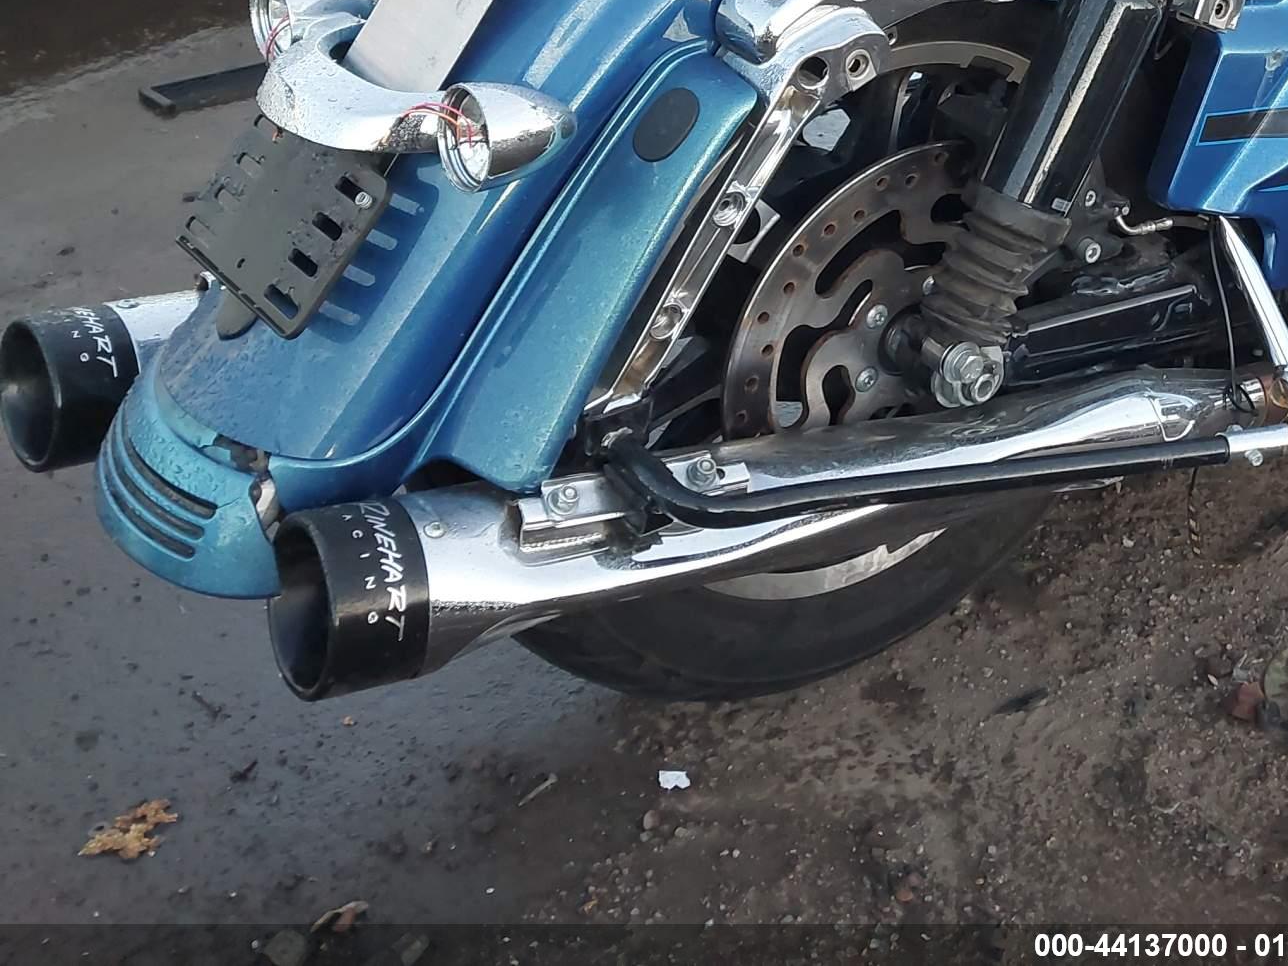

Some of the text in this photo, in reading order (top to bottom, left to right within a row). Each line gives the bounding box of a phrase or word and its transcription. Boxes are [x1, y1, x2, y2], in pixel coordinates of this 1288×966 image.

[71, 307, 118, 378] EHART
[341, 511, 379, 624] ACING
[360, 502, 406, 641] RINEHART
